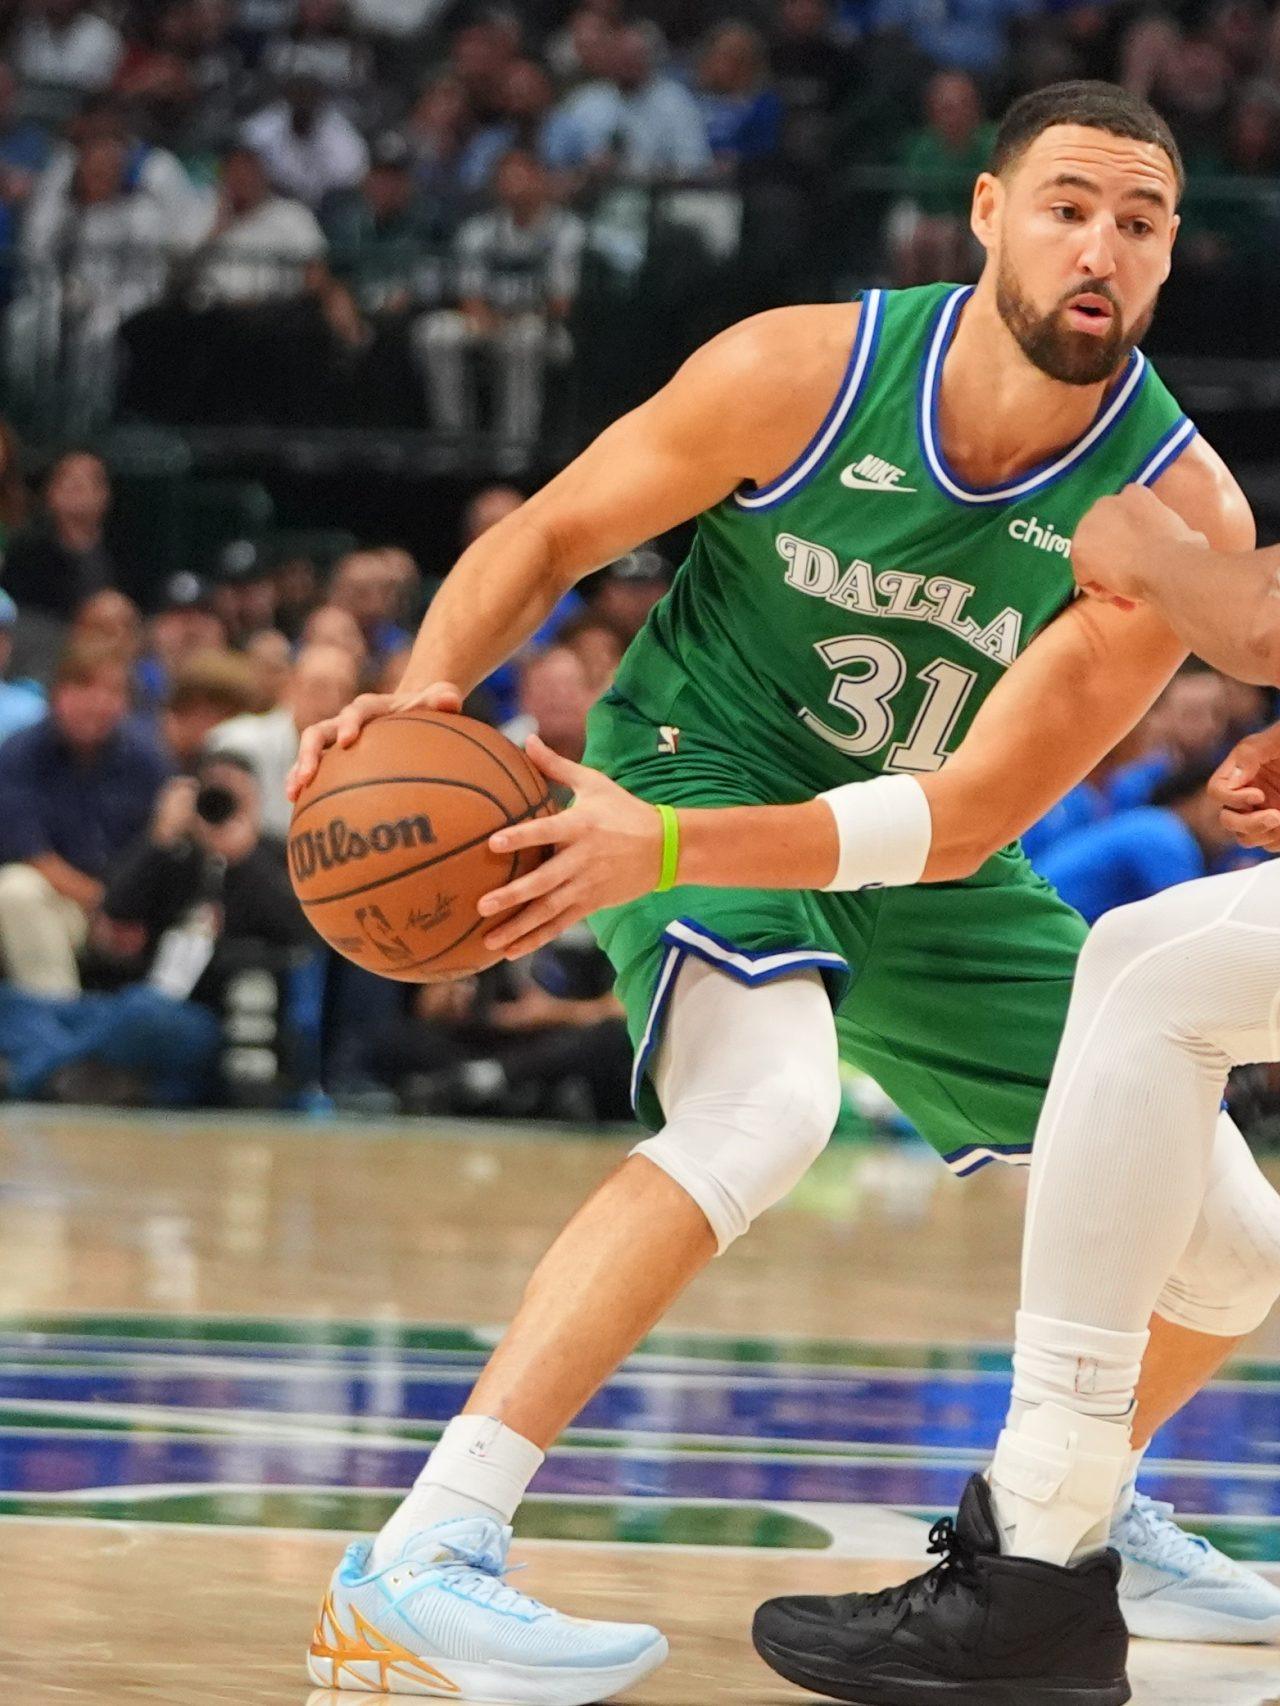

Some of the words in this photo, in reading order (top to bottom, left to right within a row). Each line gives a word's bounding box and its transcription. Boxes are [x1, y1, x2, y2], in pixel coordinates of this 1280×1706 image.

[853, 454, 906, 485] NIKE
[1008, 516, 1072, 559] chim
[775, 532, 1022, 667] DALLA
[798, 634, 978, 773] 31
[290, 813, 437, 882] Wilson
